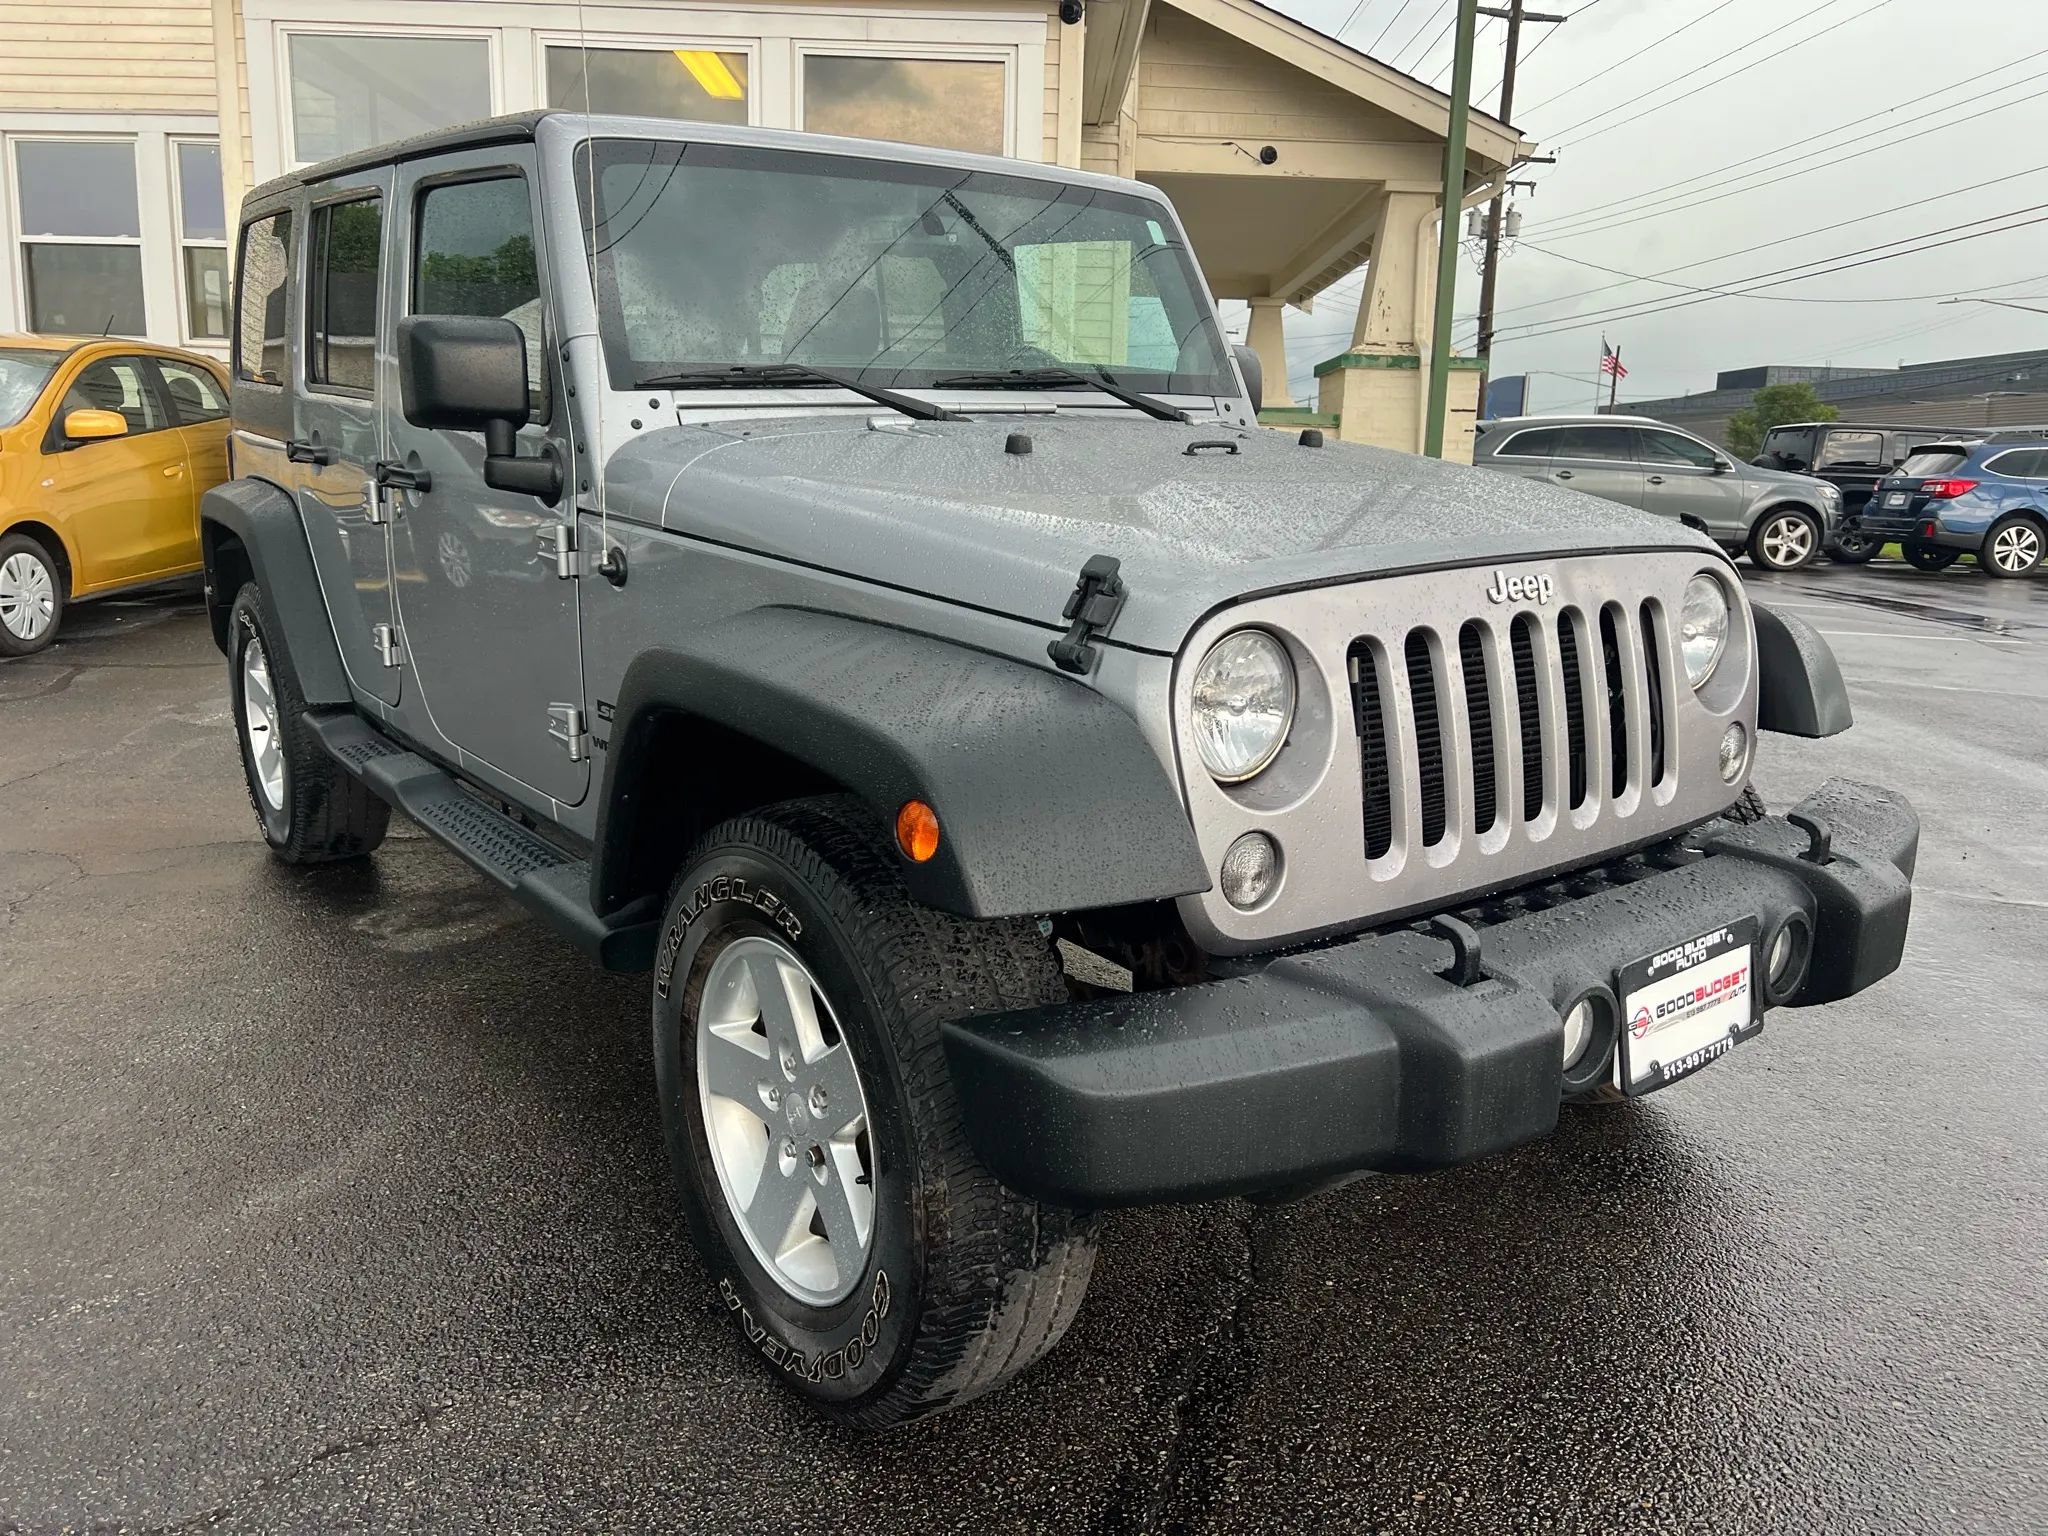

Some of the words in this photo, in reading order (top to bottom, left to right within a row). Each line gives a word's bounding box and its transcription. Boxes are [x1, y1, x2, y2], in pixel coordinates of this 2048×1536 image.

[1486, 570, 1553, 605] Jeep
[657, 876, 802, 999] WRANGLER
[1652, 945, 1683, 969] GOOD
[1684, 928, 1728, 956] BUDGET
[1676, 949, 1707, 971] AUTO
[1663, 1037, 1735, 1080] 513-997-7779
[719, 1269, 891, 1383] GOODYEAR
